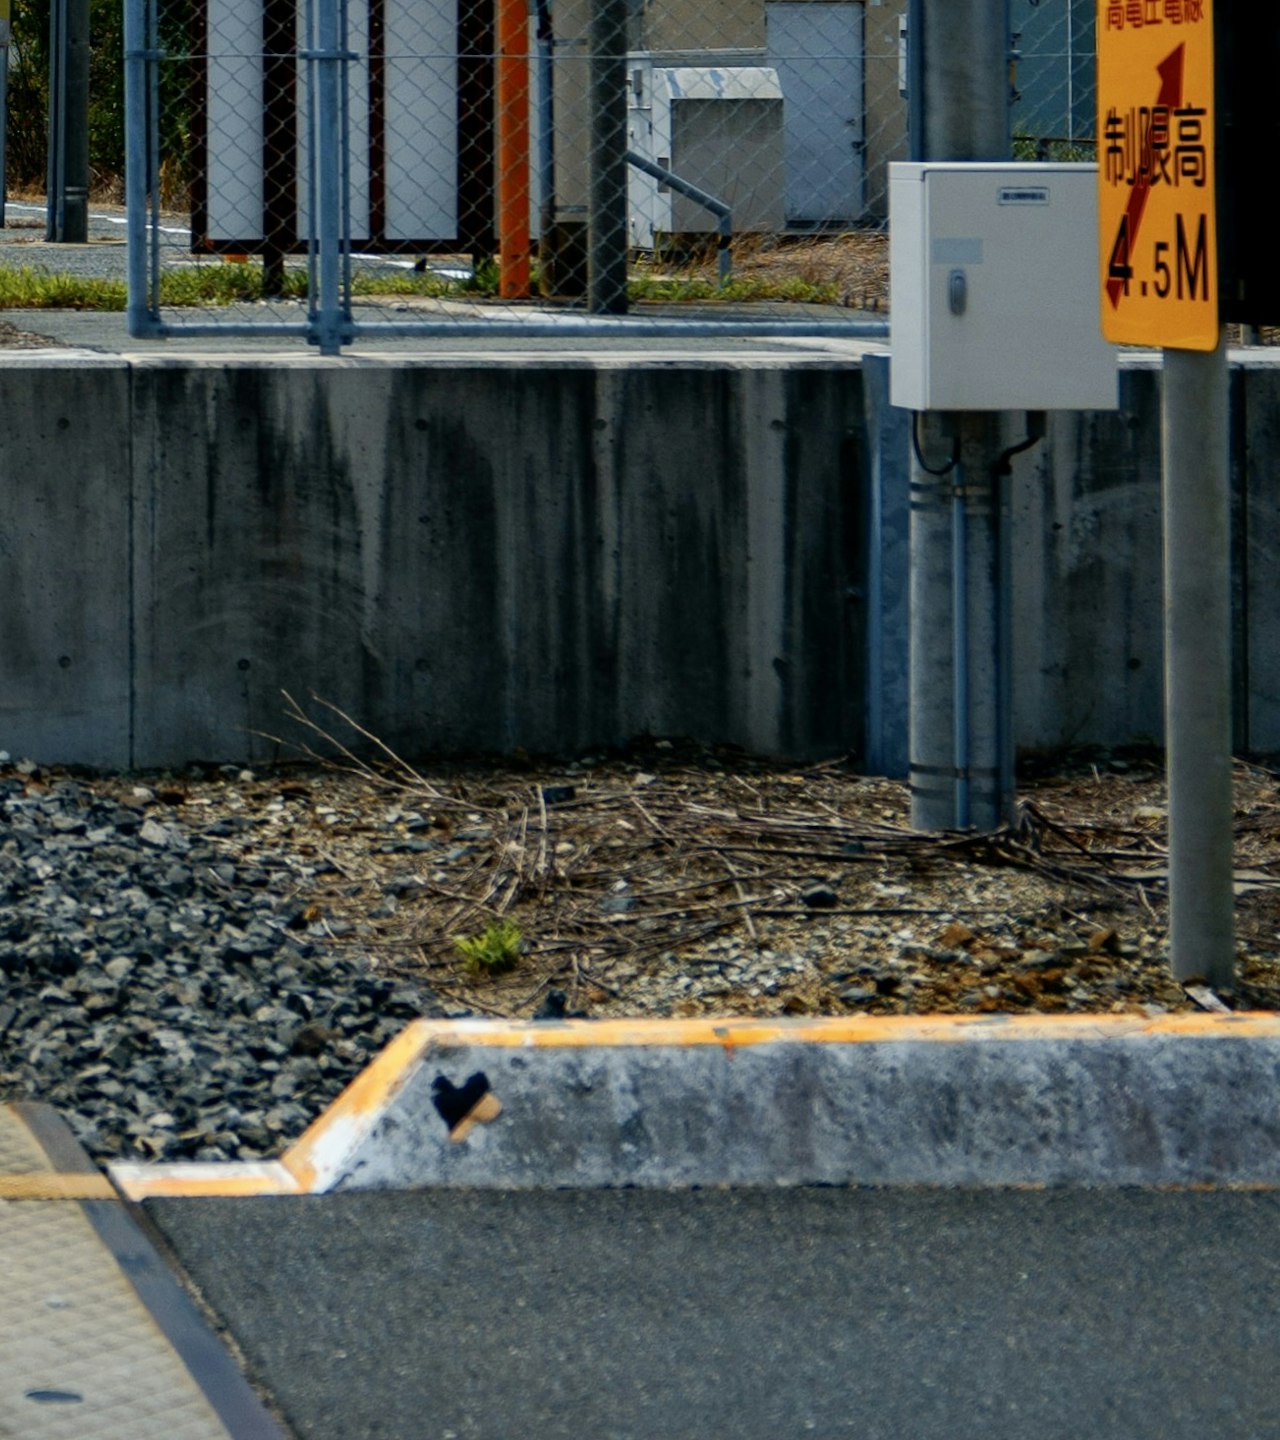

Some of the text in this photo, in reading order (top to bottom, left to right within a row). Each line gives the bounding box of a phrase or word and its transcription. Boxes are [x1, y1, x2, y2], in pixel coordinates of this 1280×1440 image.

[1104, 103, 1207, 187] 制限高
[1108, 213, 1209, 302] 4.5M
